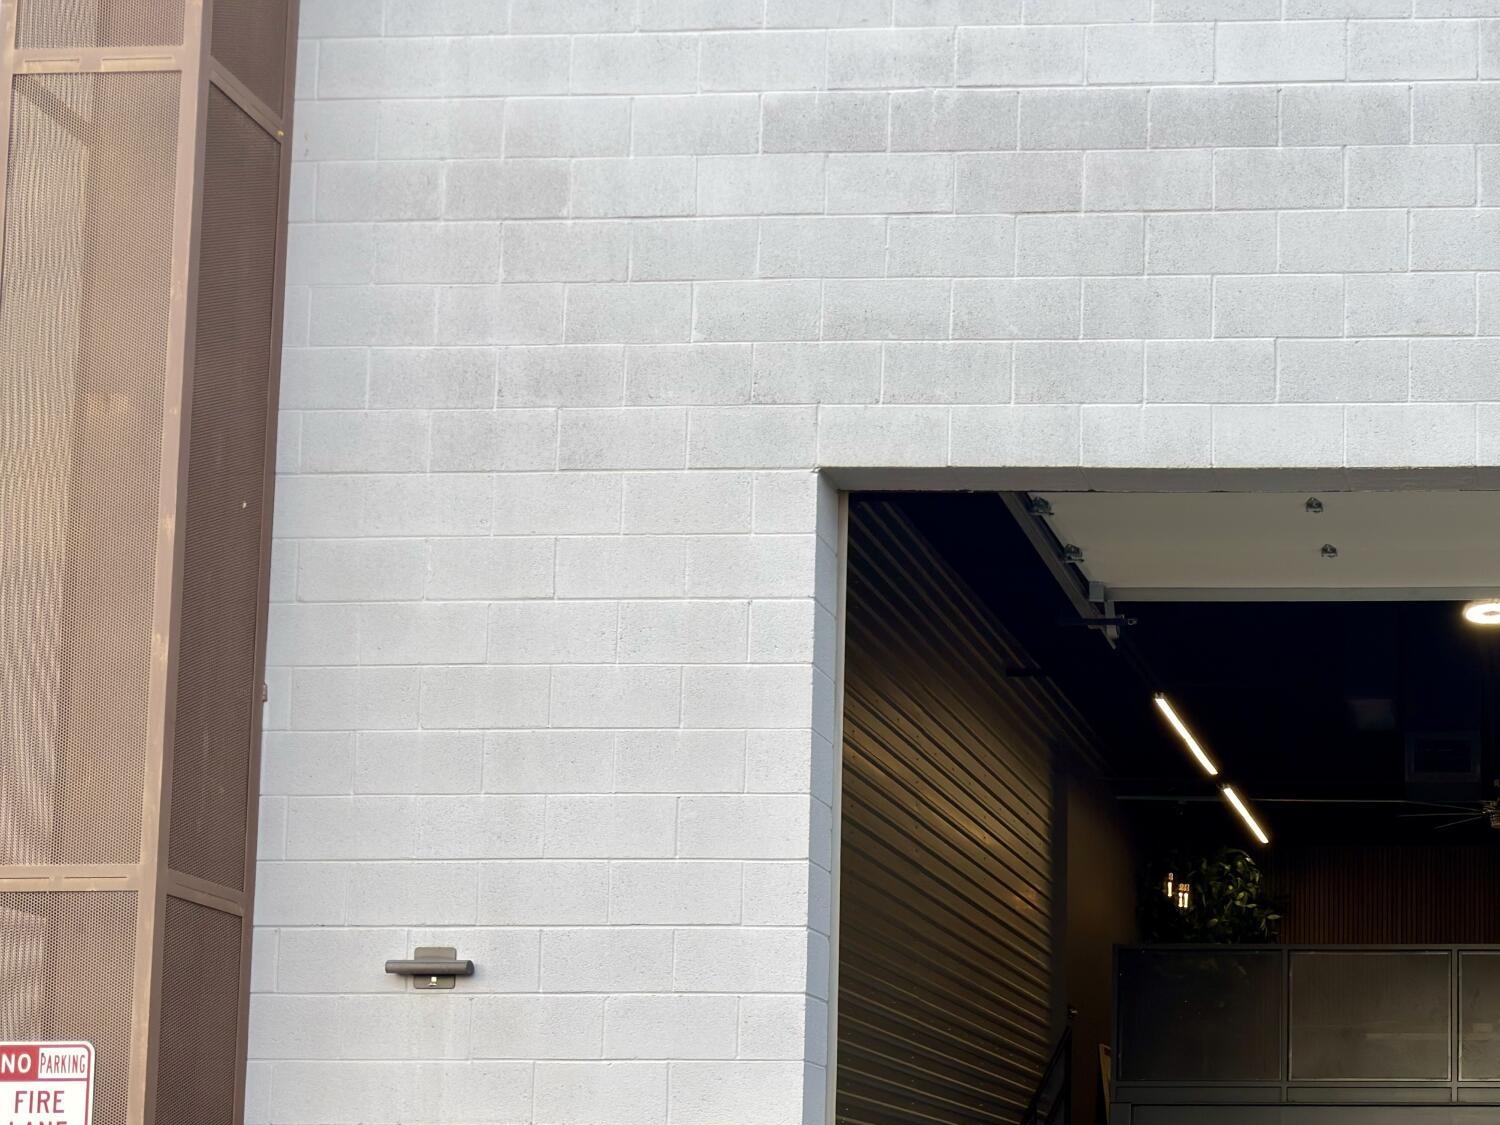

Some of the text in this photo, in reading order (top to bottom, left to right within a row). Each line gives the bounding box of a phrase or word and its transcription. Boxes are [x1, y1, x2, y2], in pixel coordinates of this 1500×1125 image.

[1, 1053, 86, 1074] NO PARKING
[14, 1090, 65, 1114] FIRE
